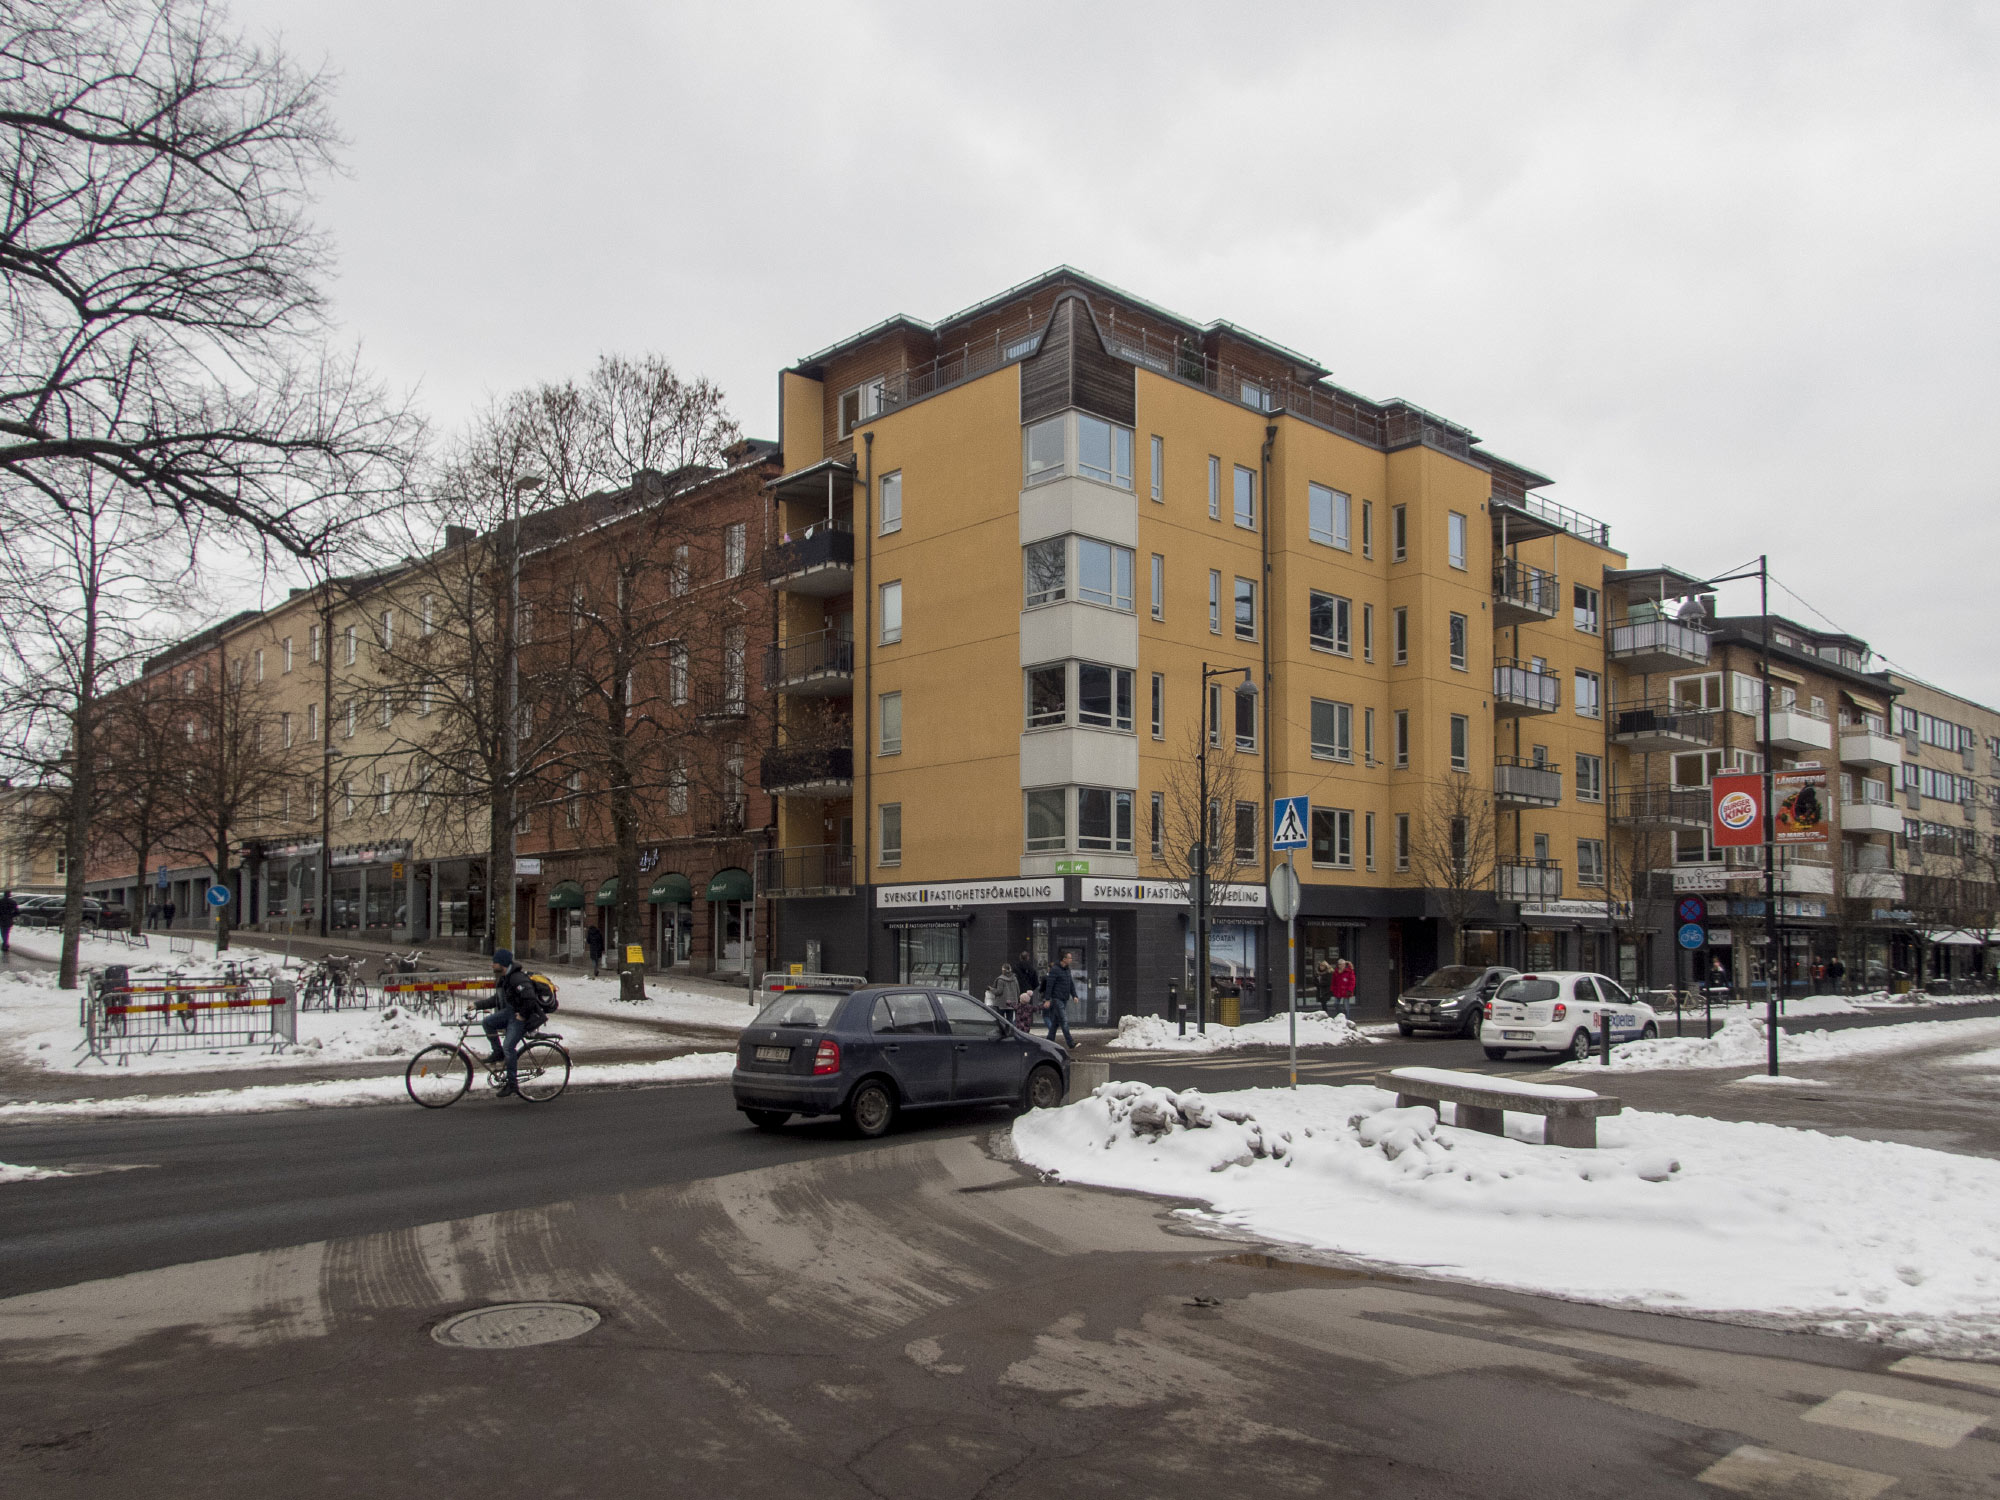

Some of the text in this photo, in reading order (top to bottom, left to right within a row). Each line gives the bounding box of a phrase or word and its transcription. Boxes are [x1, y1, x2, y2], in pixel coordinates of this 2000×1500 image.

[1723, 799, 1750, 812] BURGER
[1725, 805, 1751, 820] KING
[884, 886, 1051, 903] SVENSK FASTIGHETSFÖRMEDLING
[1094, 885, 1133, 898] SVENSK
